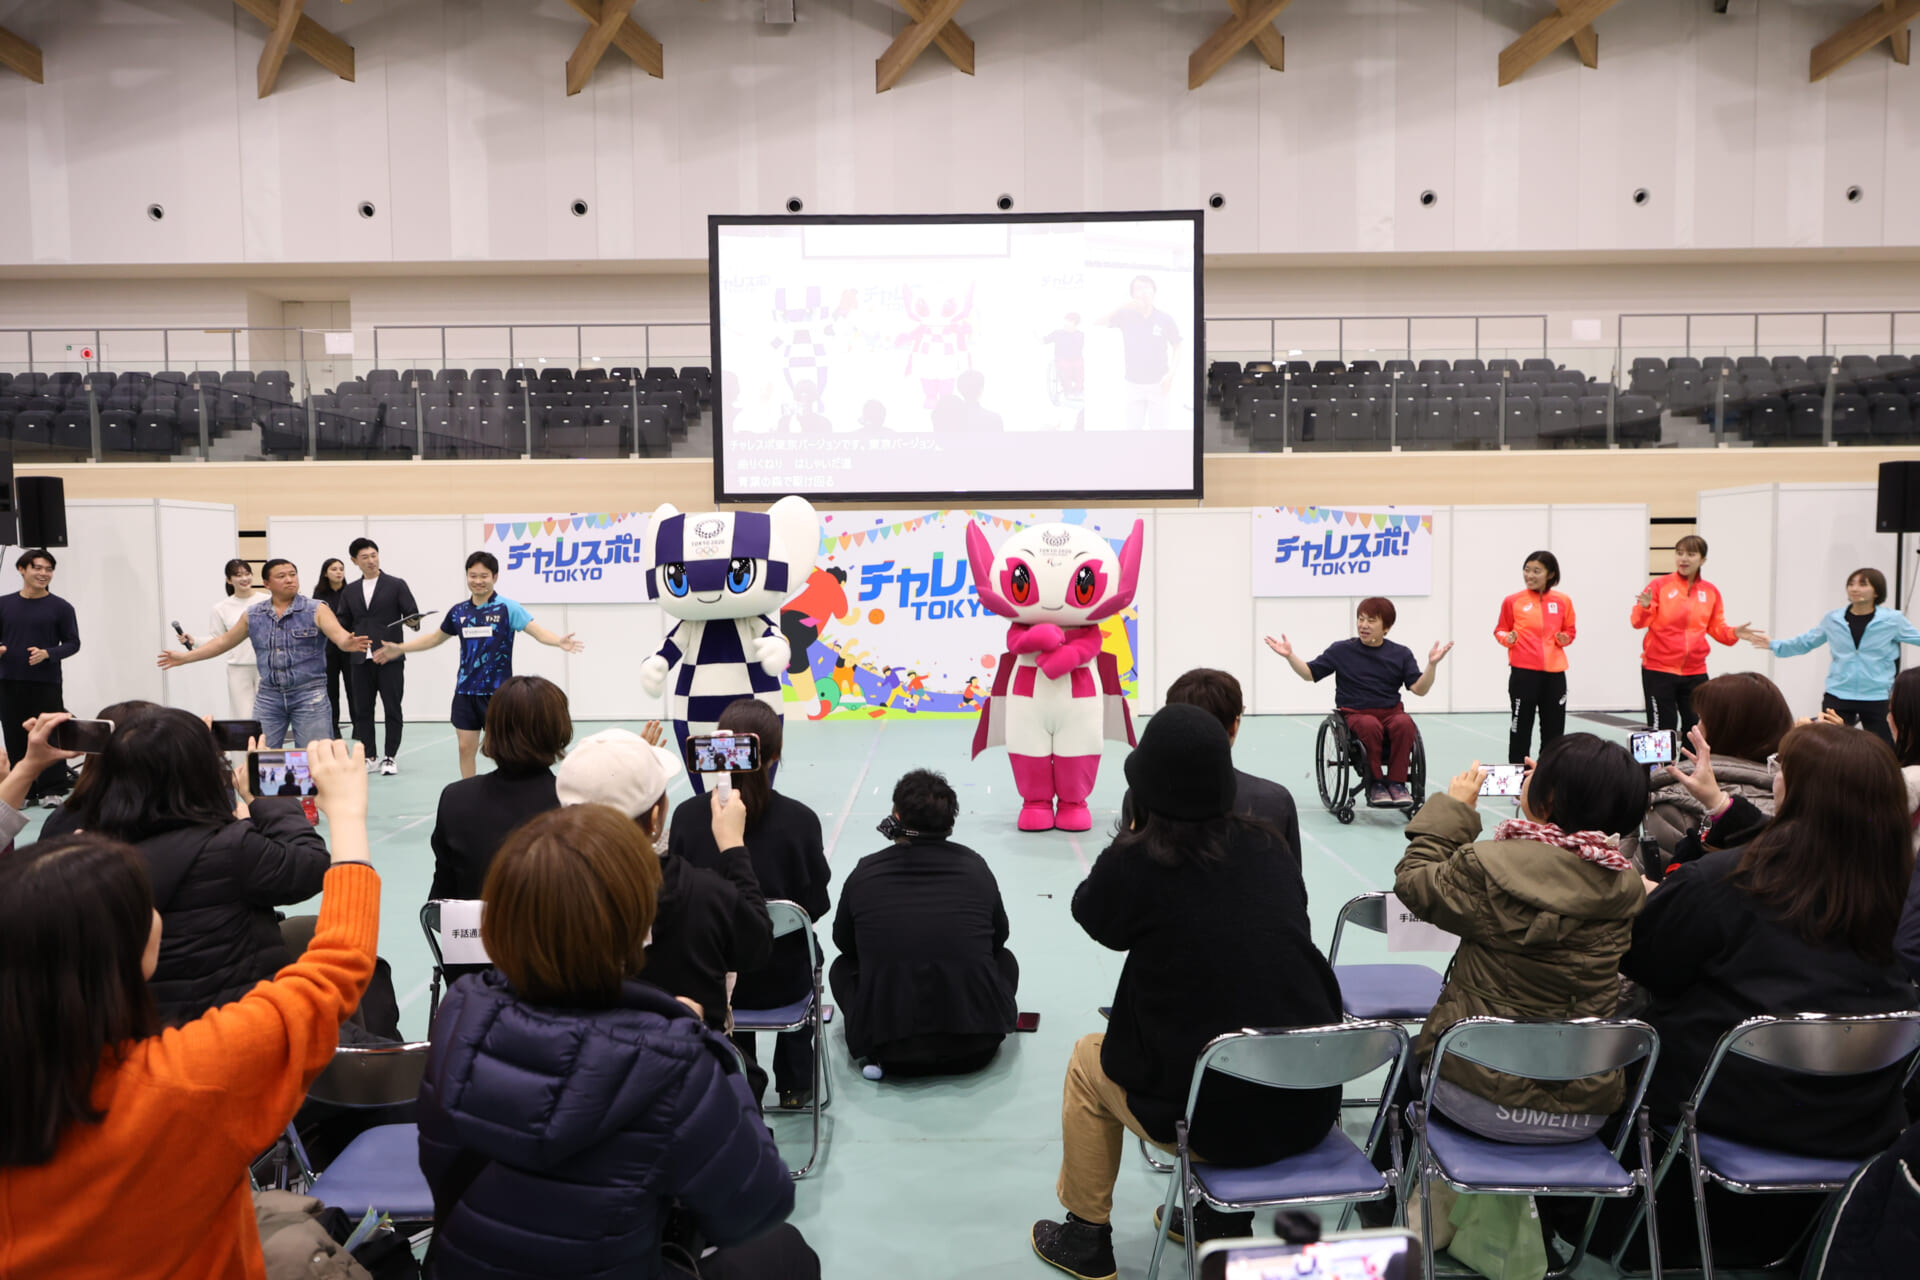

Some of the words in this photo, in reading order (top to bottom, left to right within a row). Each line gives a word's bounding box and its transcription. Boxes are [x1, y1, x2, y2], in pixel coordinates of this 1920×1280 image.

[542, 567, 602, 583] TOKYO
[1310, 560, 1370, 576] TOKYO
[452, 929, 481, 939] 手話通
